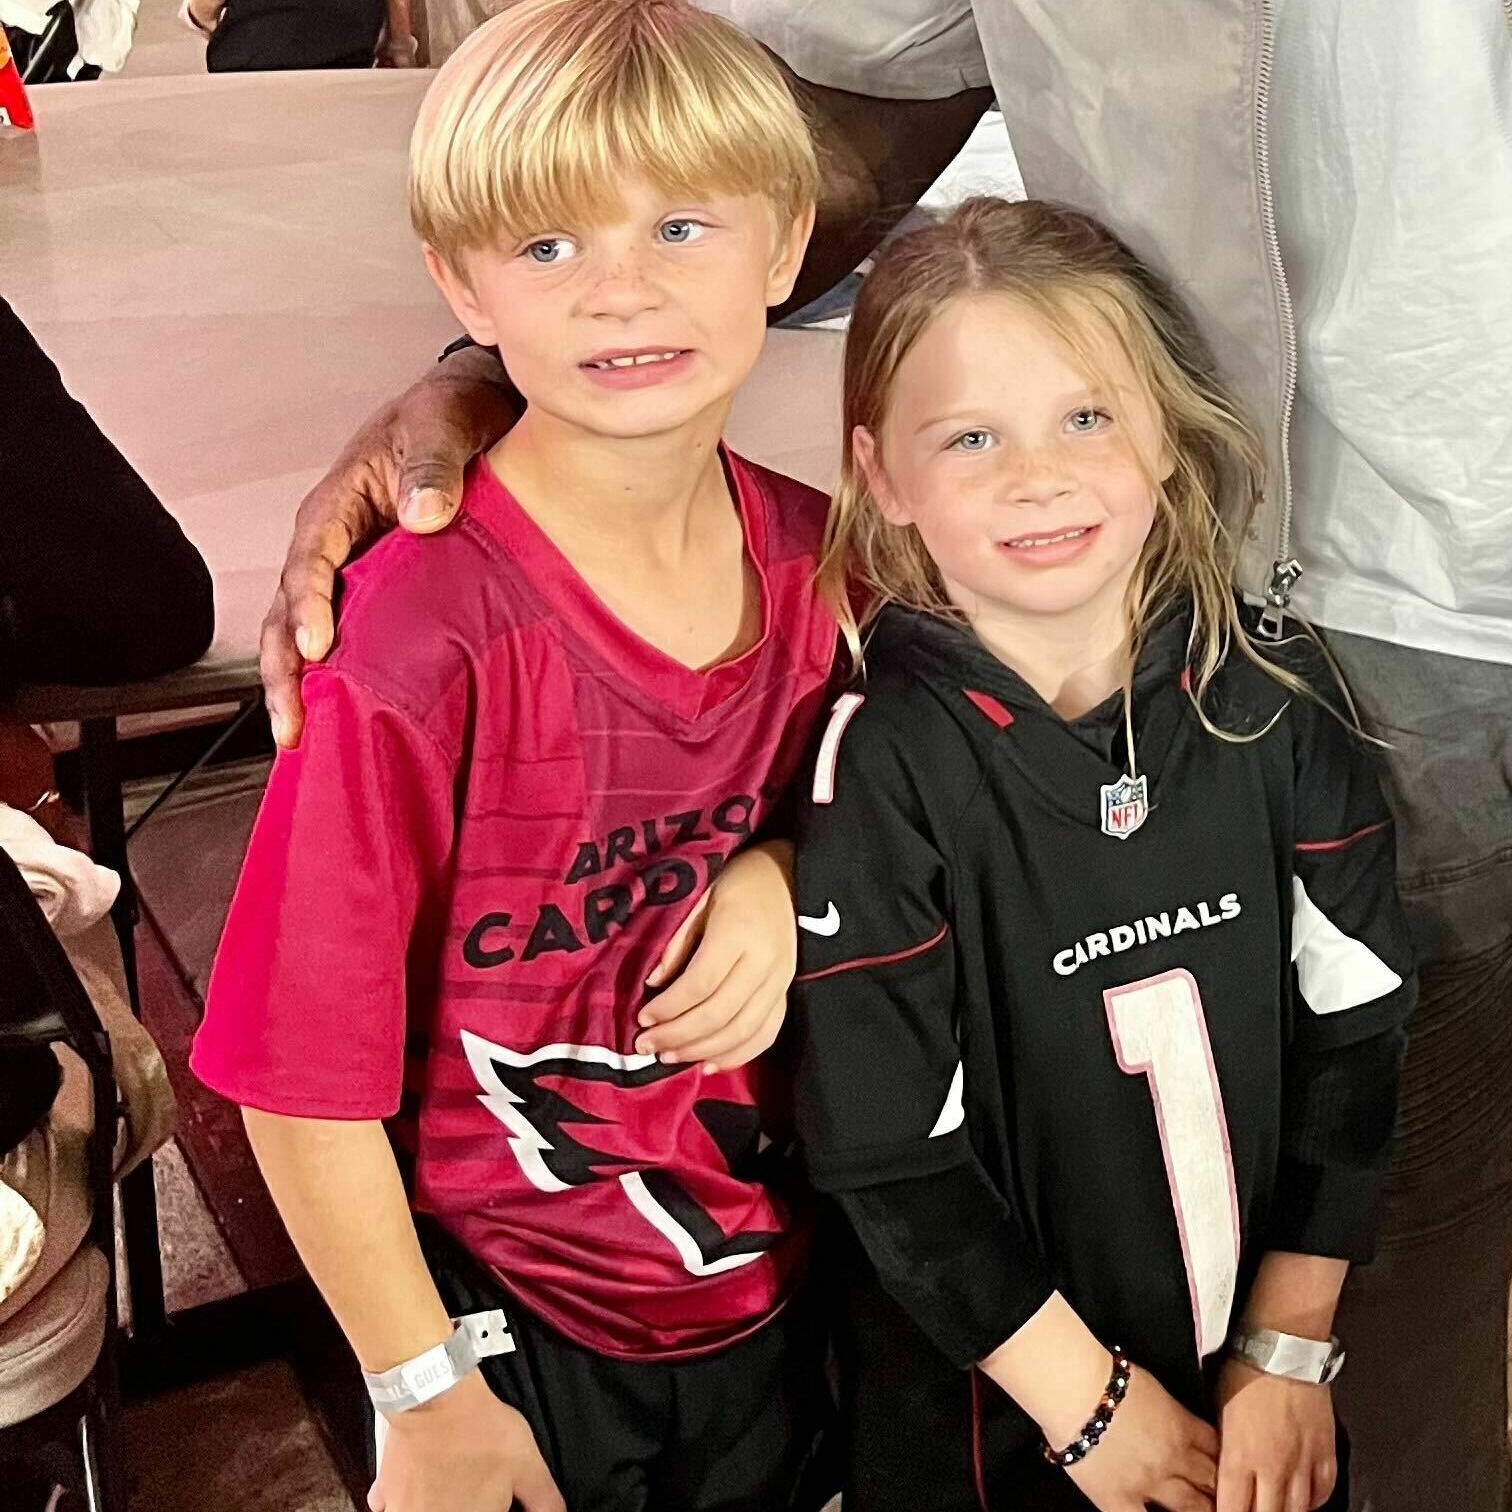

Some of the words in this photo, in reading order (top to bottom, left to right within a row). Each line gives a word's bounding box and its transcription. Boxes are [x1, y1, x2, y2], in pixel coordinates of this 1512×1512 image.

[811, 691, 866, 804] 1
[1053, 893, 1242, 976] CARDINALS
[1102, 967, 1241, 1370] 1
